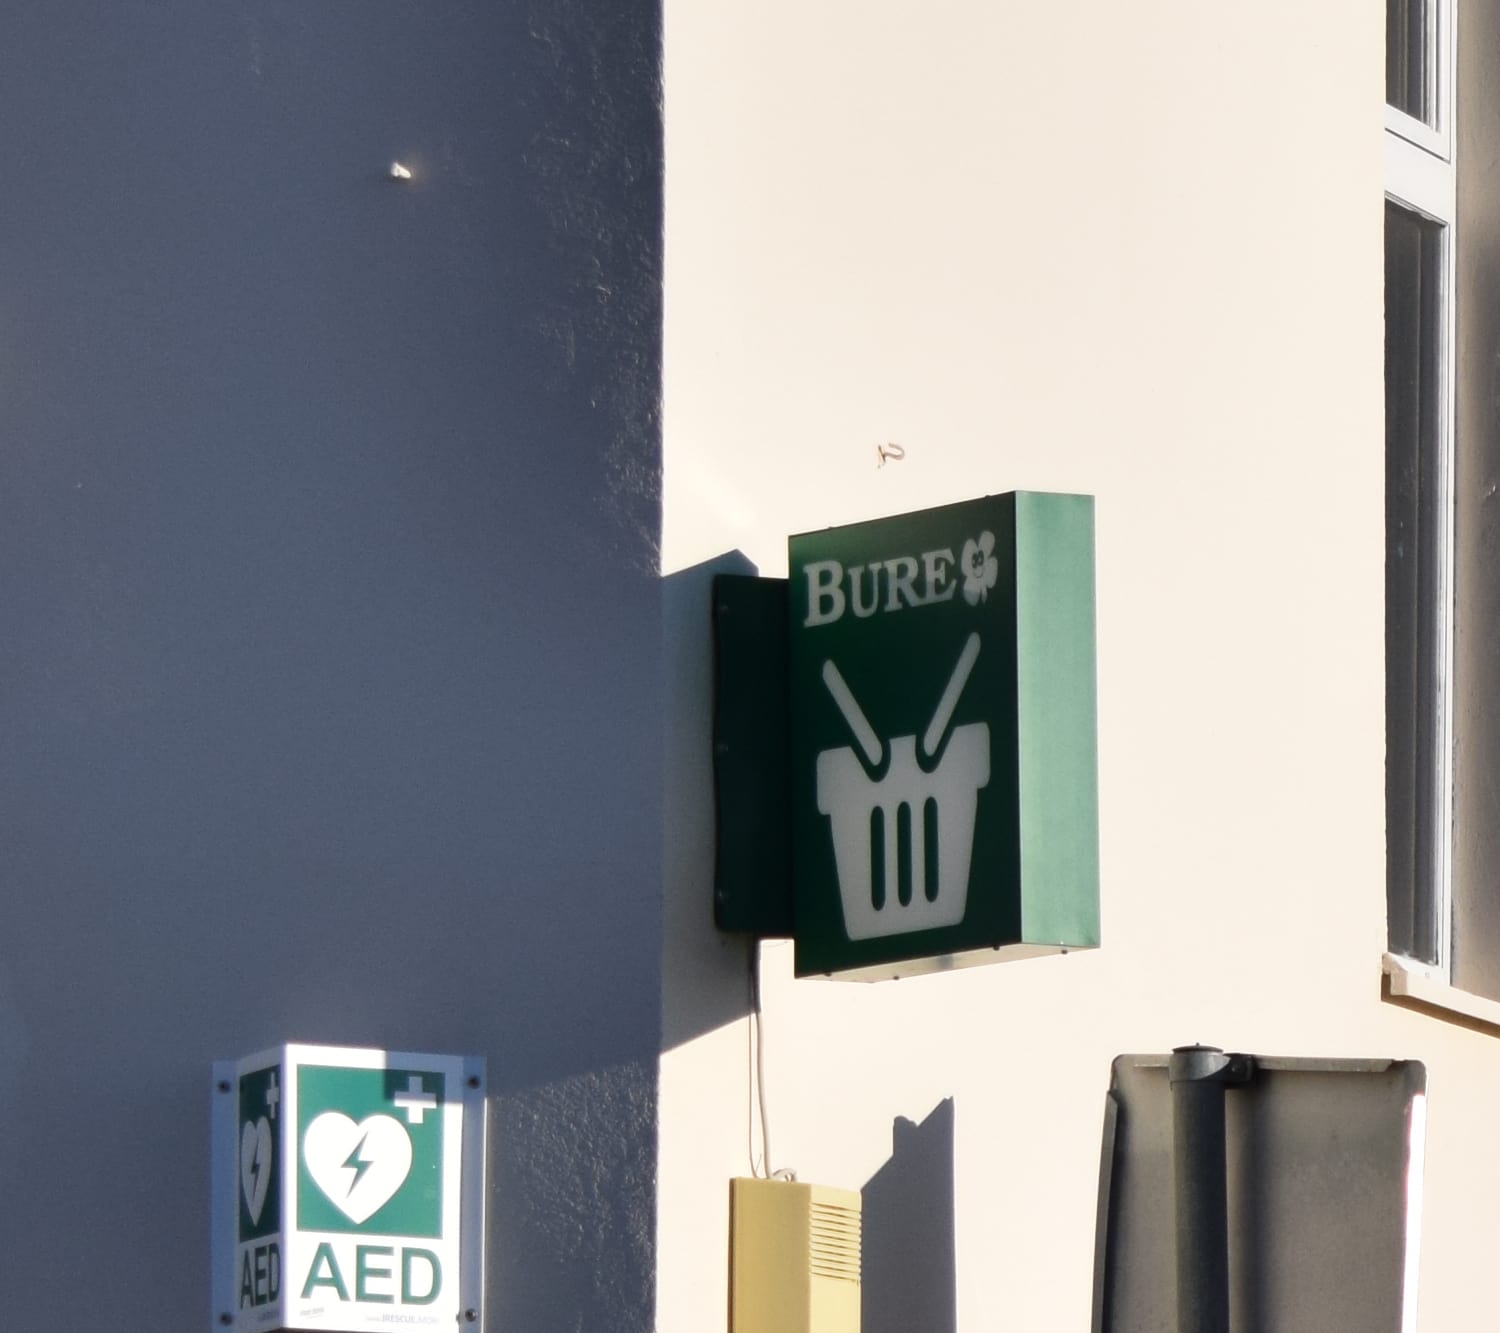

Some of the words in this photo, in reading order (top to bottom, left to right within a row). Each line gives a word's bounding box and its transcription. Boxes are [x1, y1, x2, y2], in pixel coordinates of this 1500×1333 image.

[803, 548, 957, 628] BURE
[240, 1242, 281, 1310] AED
[299, 1242, 443, 1306] AED
